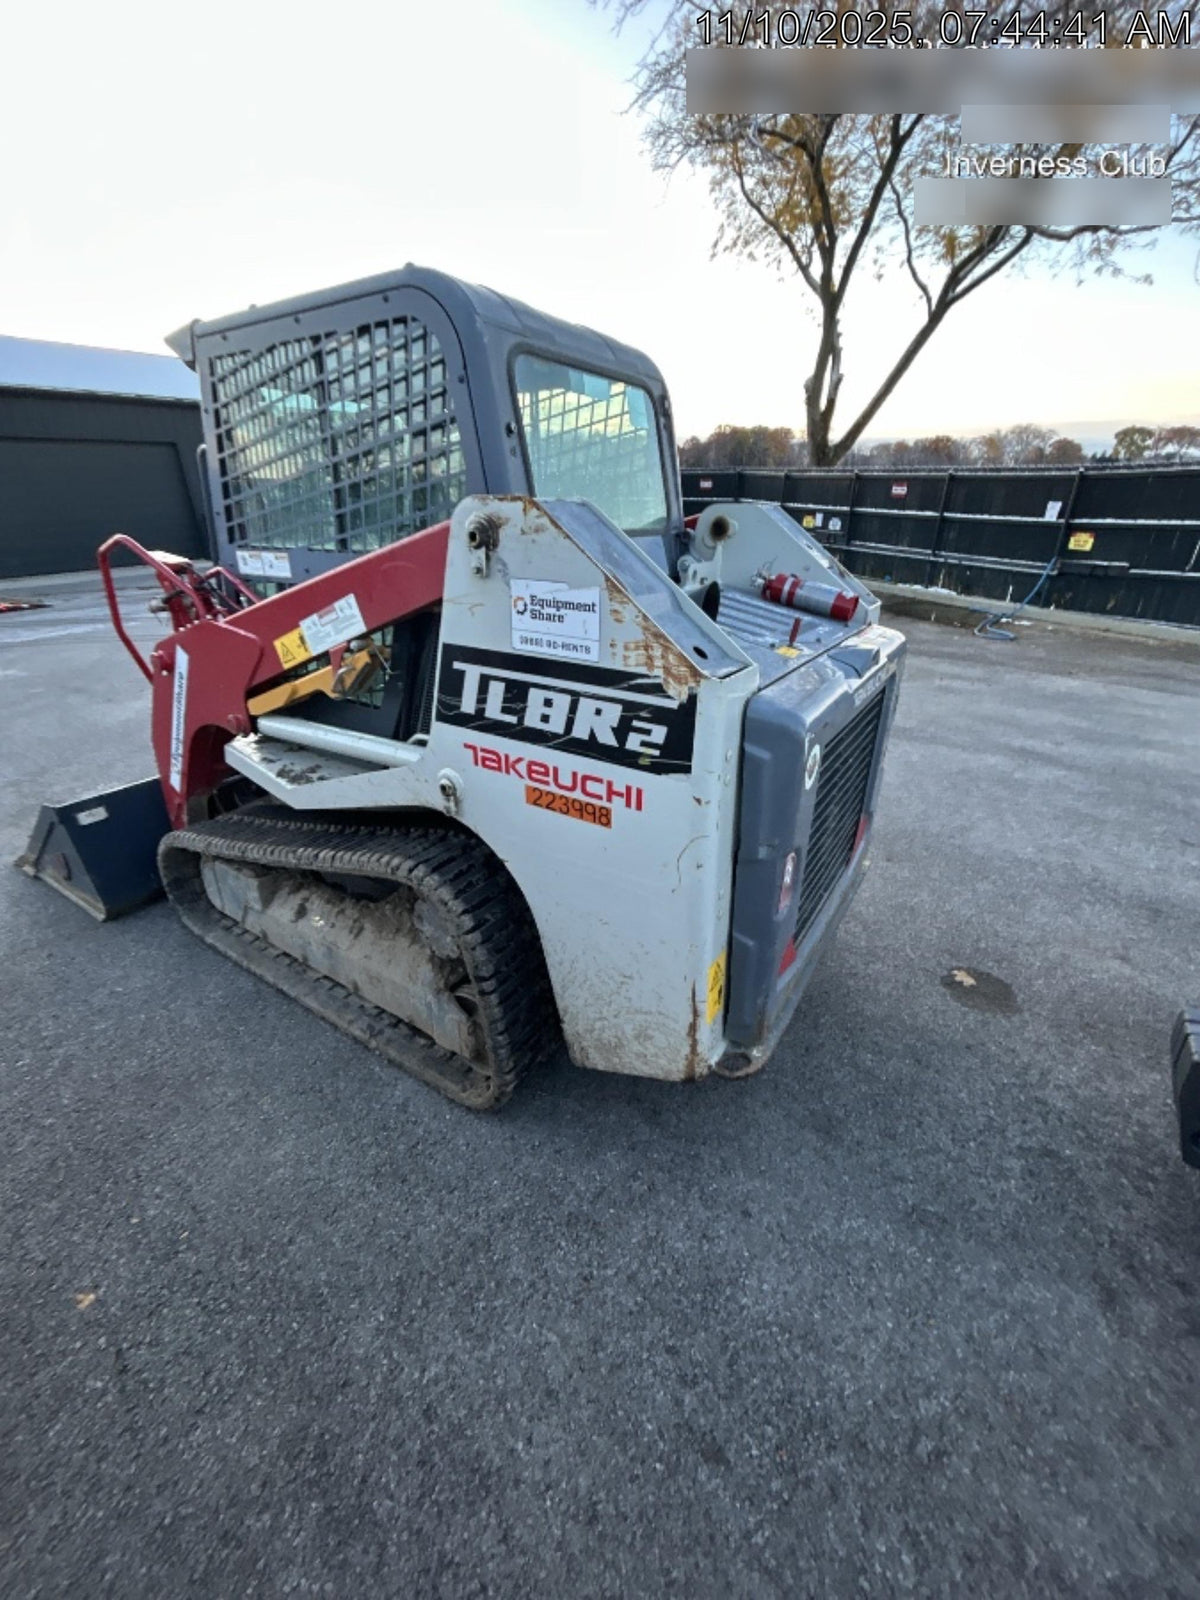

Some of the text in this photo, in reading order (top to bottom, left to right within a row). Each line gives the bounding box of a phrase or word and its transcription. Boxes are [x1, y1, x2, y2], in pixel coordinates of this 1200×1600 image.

[529, 594, 597, 613] Equipment
[529, 608, 565, 623] Share
[531, 787, 612, 827] 223998
